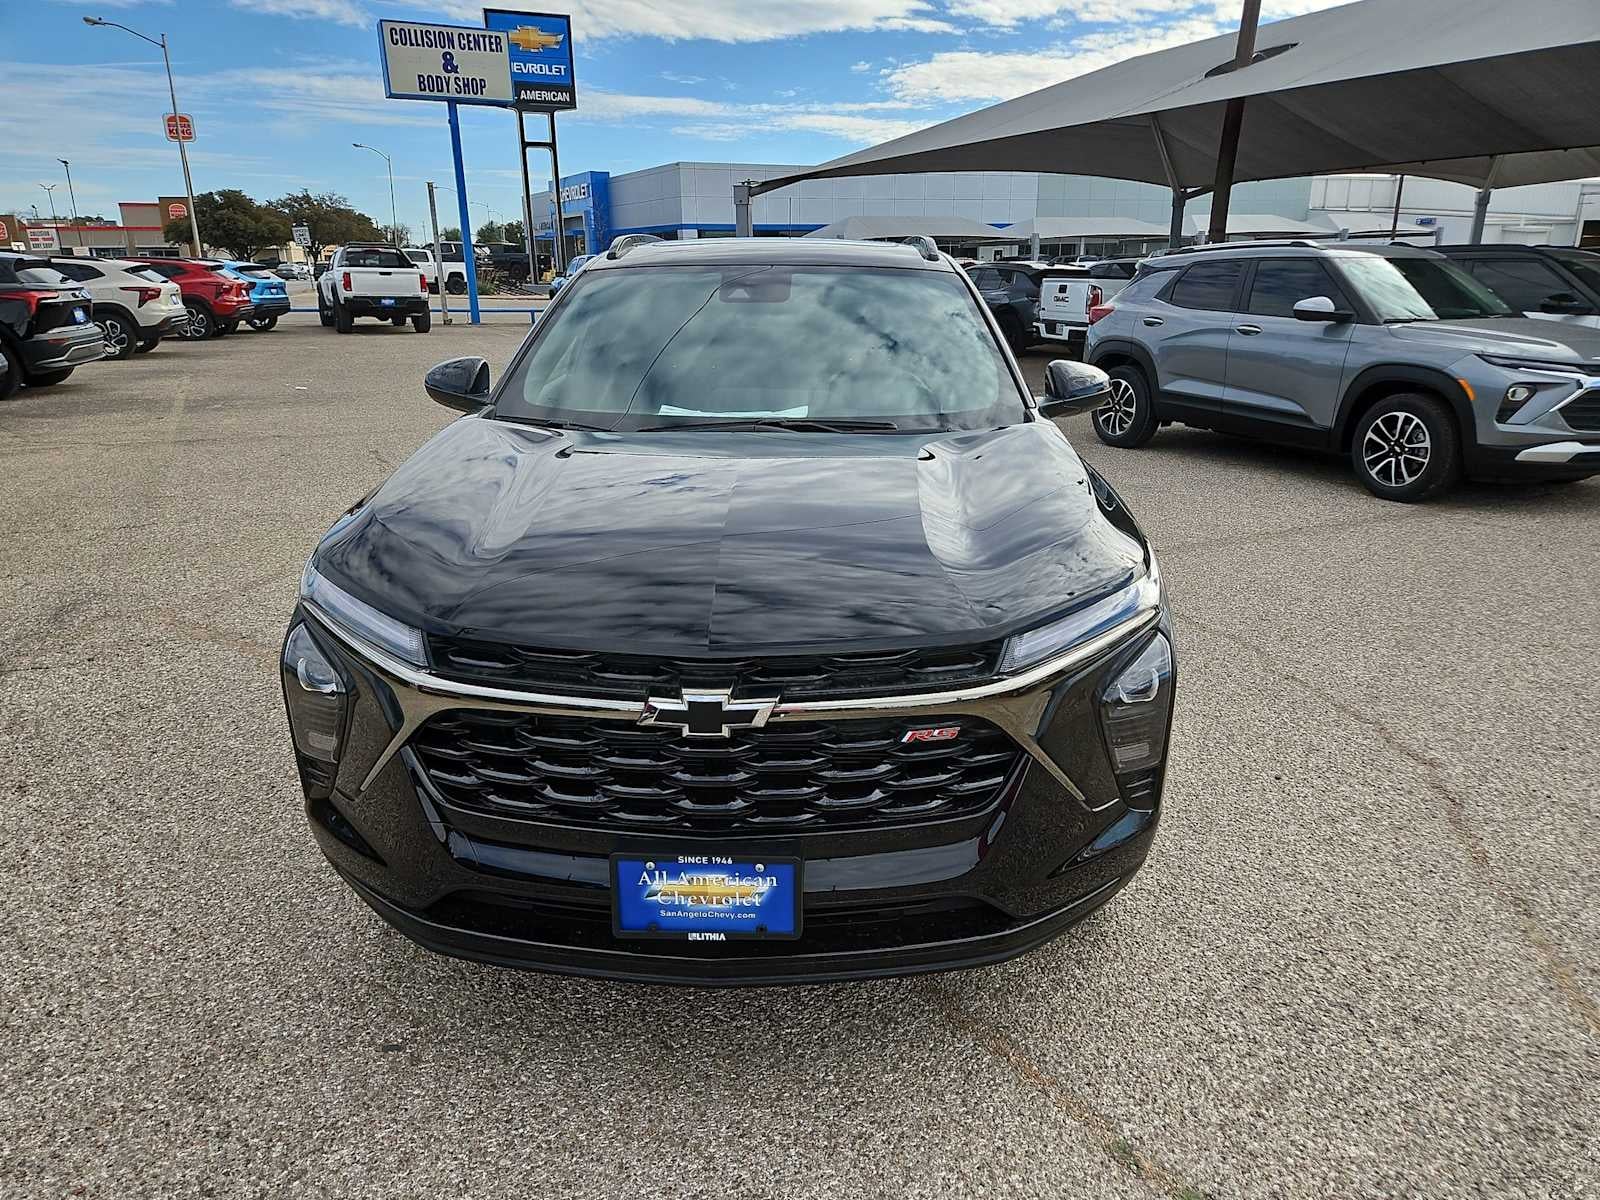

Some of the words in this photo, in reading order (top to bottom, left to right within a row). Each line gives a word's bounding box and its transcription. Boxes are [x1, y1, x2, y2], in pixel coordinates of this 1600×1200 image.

[389, 27, 455, 50] COLLISION
[457, 32, 504, 53] CENTER
[441, 51, 459, 74] &
[417, 74, 453, 94] BODY
[454, 77, 487, 96] SHOP
[520, 90, 570, 103] AMERICAN
[900, 727, 961, 743] RS
[677, 855, 709, 865] SINCE
[711, 856, 733, 865] 1946
[638, 870, 668, 887] All
[677, 871, 778, 888] American
[657, 891, 761, 908] Chevrolet
[659, 909, 756, 920] SanAngeloChevy.com
[697, 932, 726, 942] LITHIA
